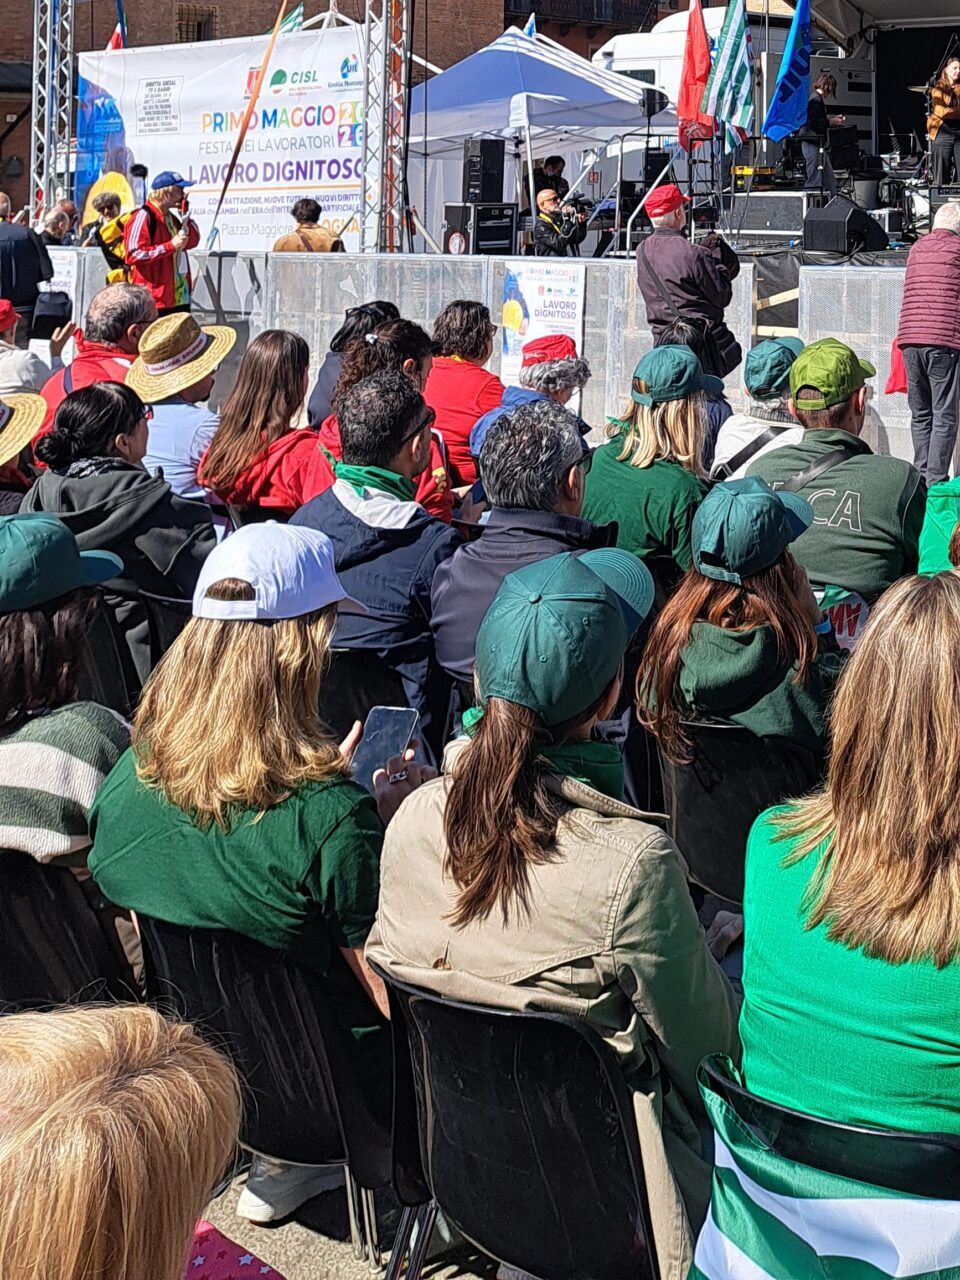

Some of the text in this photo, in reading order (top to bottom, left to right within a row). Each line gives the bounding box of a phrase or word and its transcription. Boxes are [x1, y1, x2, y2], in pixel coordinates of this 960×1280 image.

[291, 70, 319, 84] CISL
[202, 110, 259, 133] PRIMO
[262, 104, 336, 130] MAGGIO
[199, 140, 234, 155] FESTA
[258, 135, 335, 152] LAVORATORI
[189, 162, 258, 185] LAVORO
[221, 222, 250, 236] Piazza
[252, 222, 294, 238] Maggiore
[543, 300, 577, 310] LAVORO
[535, 309, 577, 320] DIGNITOSO
